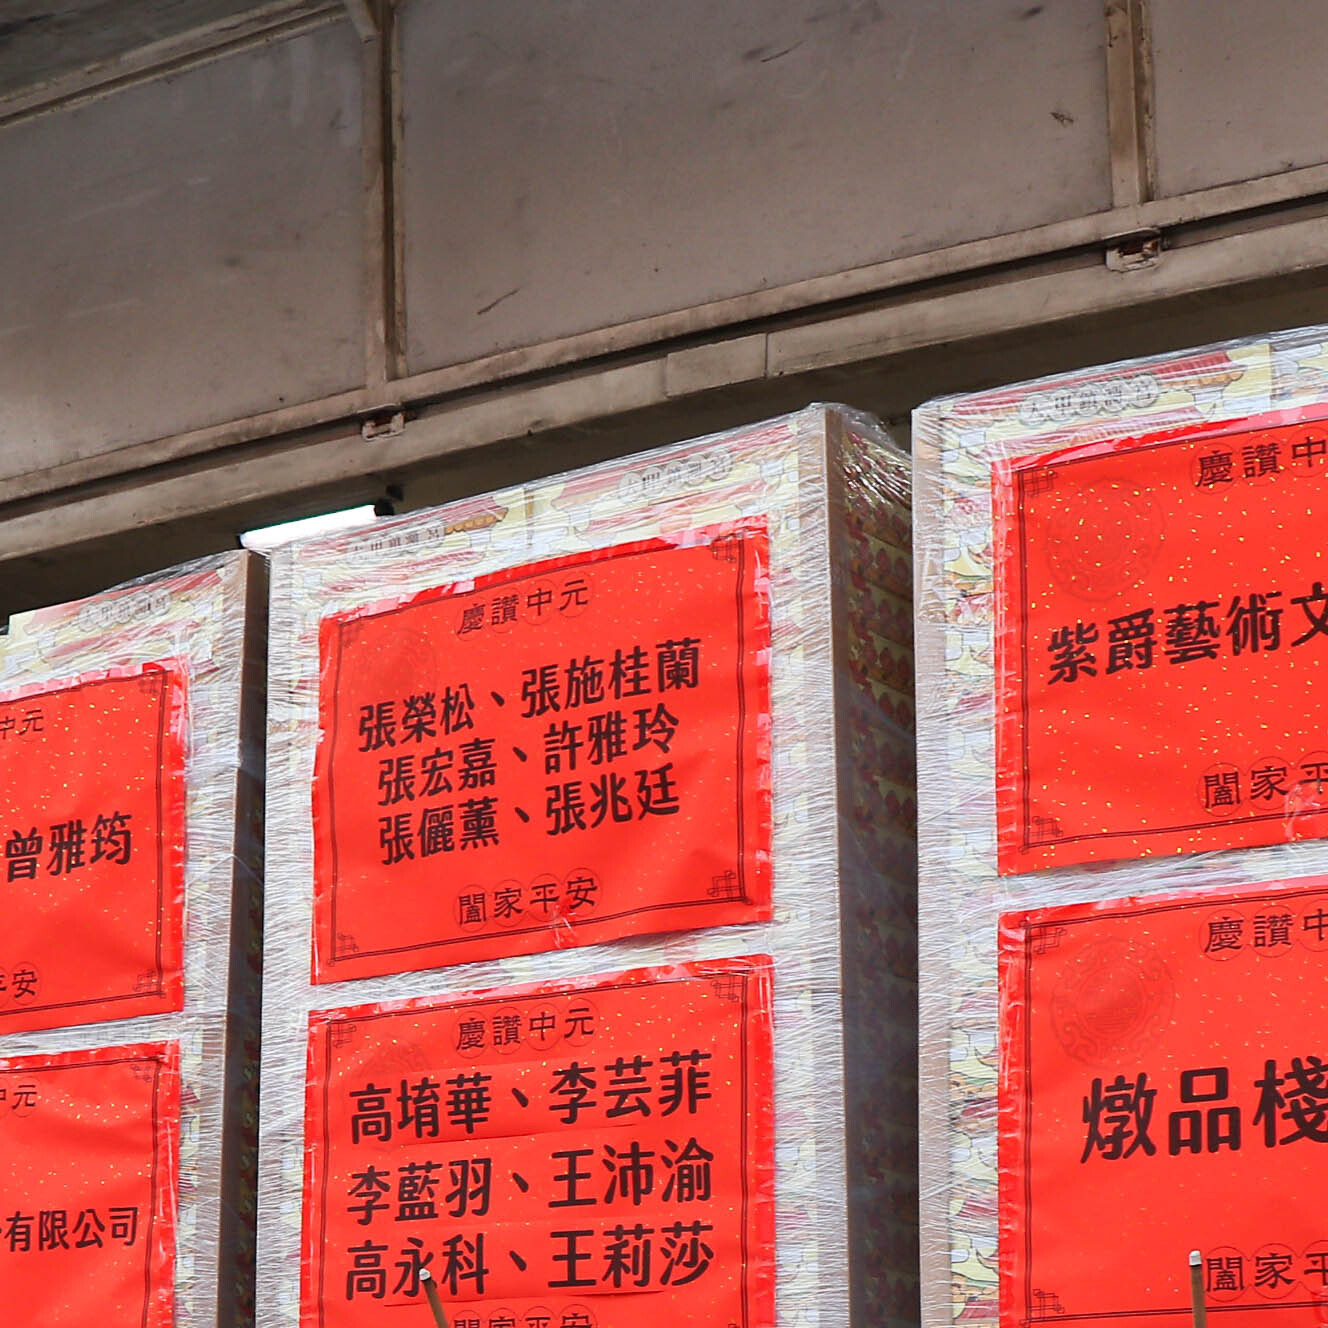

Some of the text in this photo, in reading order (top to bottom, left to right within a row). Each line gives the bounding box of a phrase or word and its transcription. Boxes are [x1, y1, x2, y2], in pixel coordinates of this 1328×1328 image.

[457, 580, 589, 635] 慶讚中元
[456, 1008, 594, 1050] 慶讚中元
